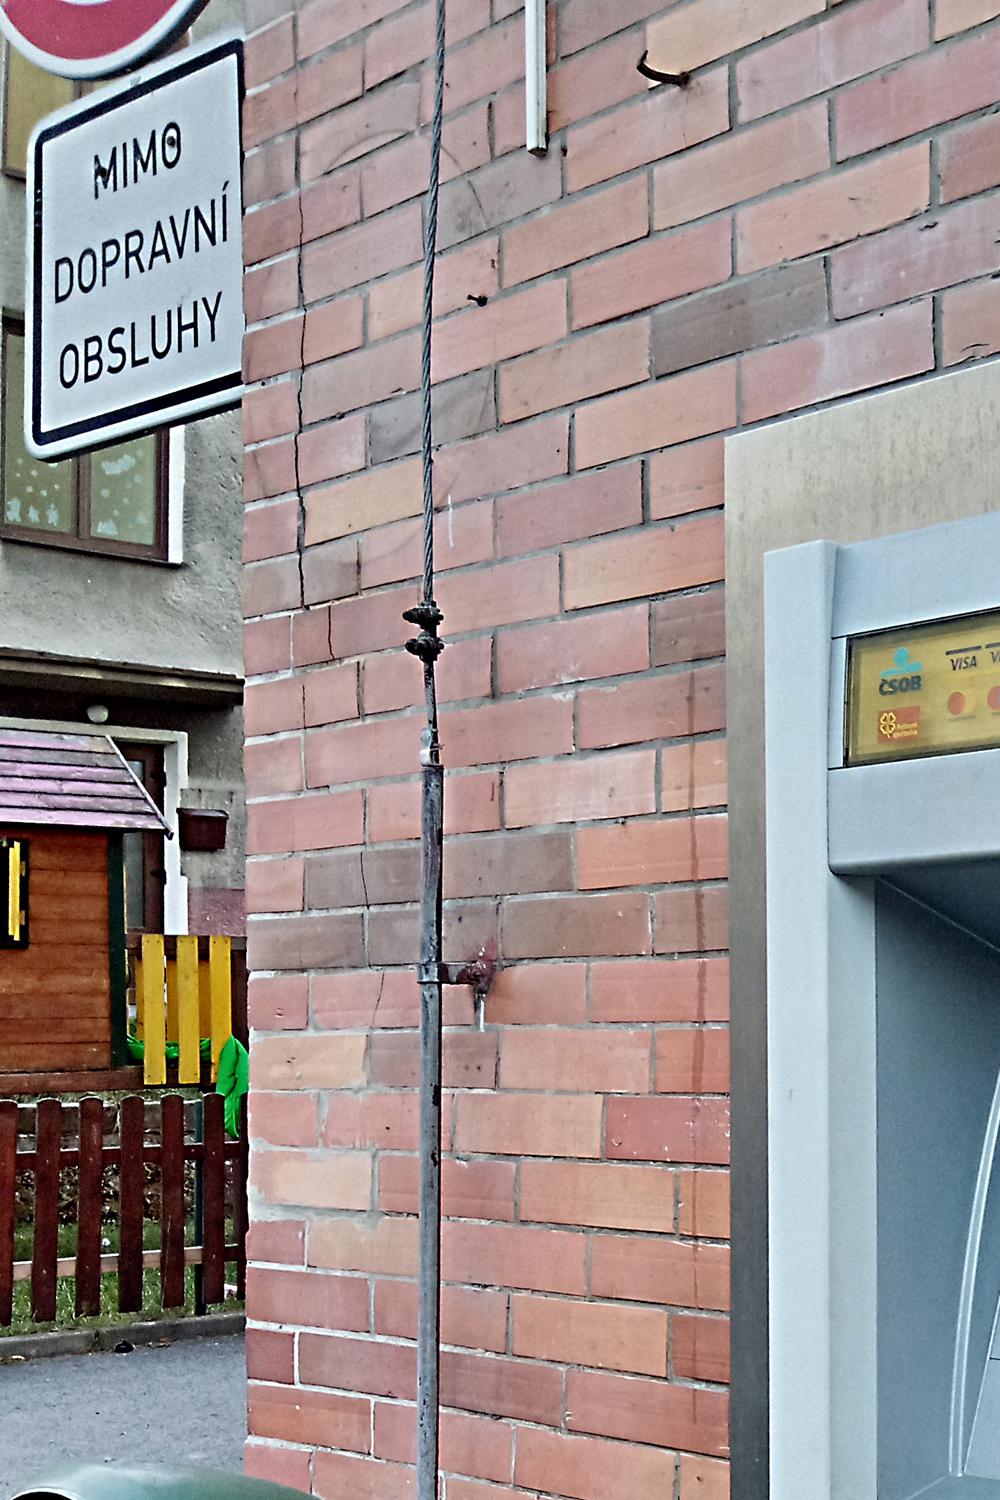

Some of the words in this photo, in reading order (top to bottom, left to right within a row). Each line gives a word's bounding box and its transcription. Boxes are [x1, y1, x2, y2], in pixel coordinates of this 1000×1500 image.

[93, 121, 182, 200] MIMO
[54, 180, 230, 304] DOPRAVNÍ
[59, 291, 223, 390] OBSLUHY
[878, 675, 922, 697] ČSOB
[951, 656, 978, 671] VISA
